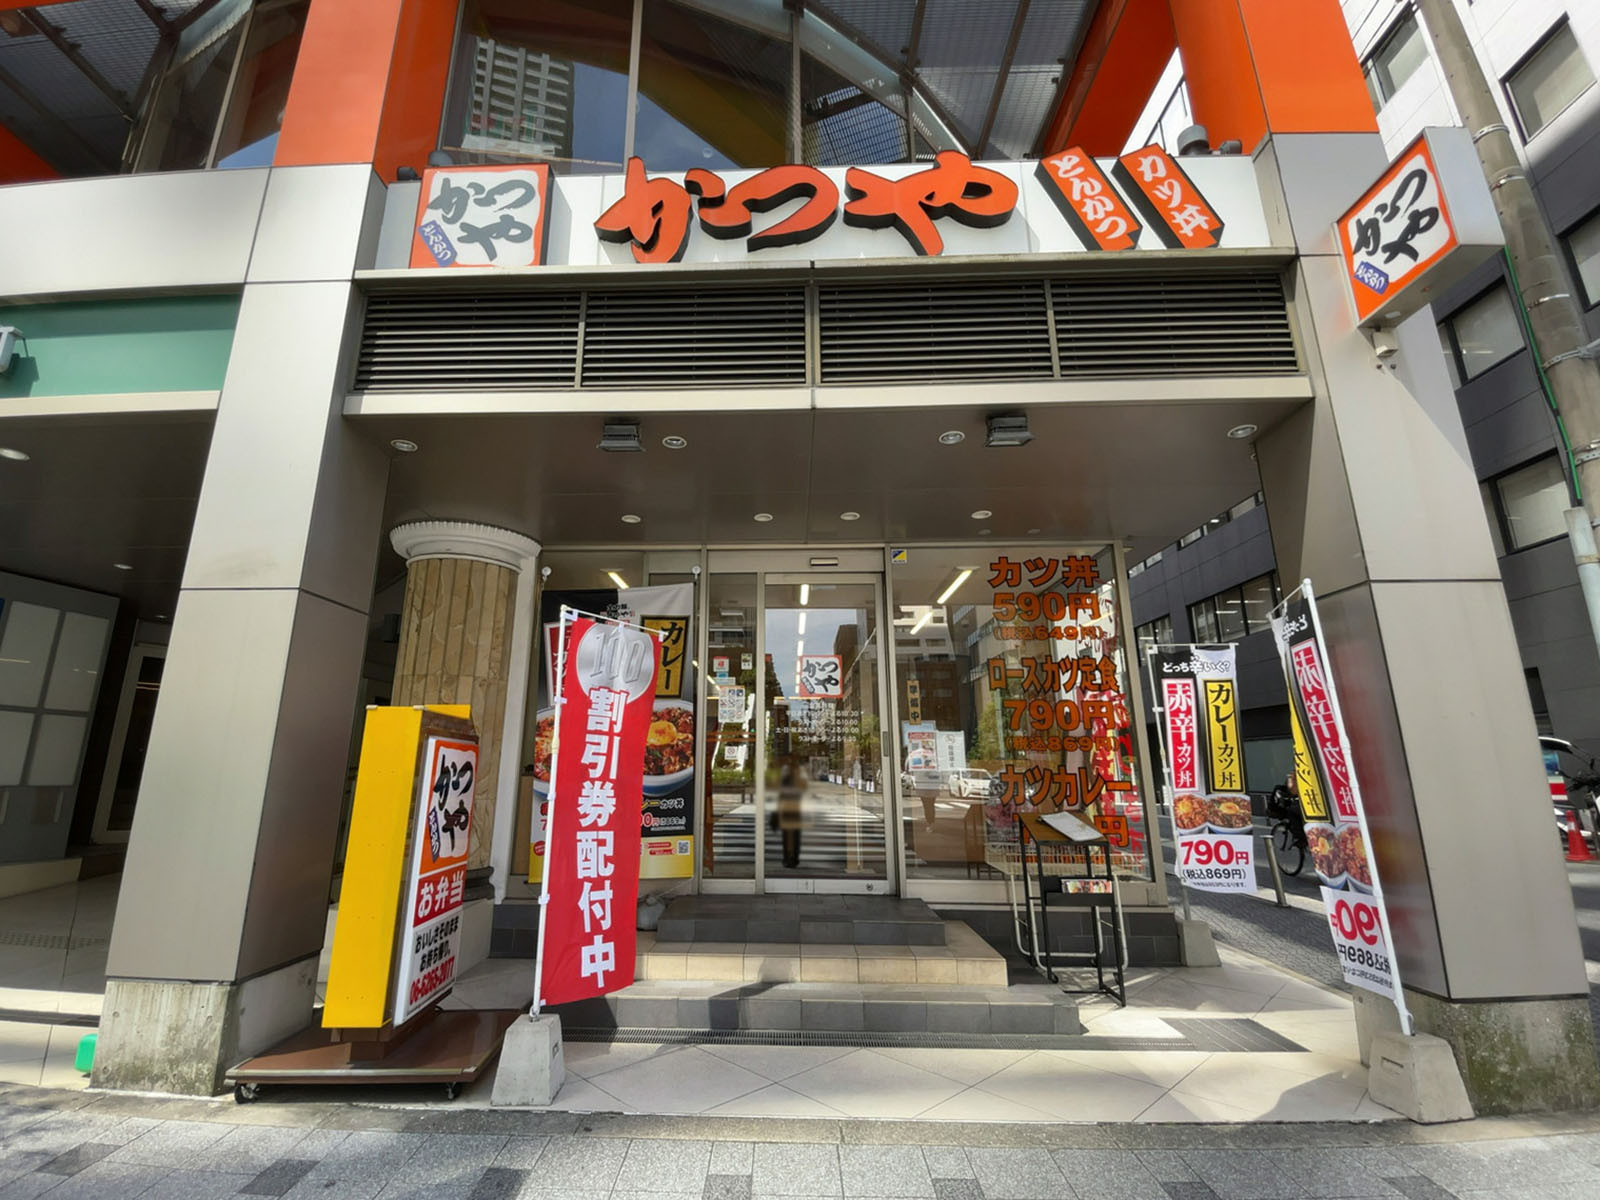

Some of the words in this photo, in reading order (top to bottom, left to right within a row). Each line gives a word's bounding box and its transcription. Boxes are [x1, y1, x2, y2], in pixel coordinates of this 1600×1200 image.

[594, 150, 1019, 263] かつや
[1050, 154, 1128, 240] とんかつ
[1137, 155, 1209, 238] カツ丼
[987, 555, 1100, 588] カツ丼
[992, 591, 1102, 622] 590円
[660, 621, 685, 691] カレー
[988, 654, 1121, 694] ロースカツ定食
[1003, 699, 1117, 731] 790円
[1167, 682, 1194, 788] 赤辛カツ丼
[1208, 683, 1237, 789] カレーカツ丼
[999, 763, 1133, 807] カツカレー
[576, 687, 629, 989] 割引券配付中
[1180, 839, 1250, 866] 790円
[417, 870, 465, 919] お弁当
[1182, 867, 1247, 880] (税込869円)
